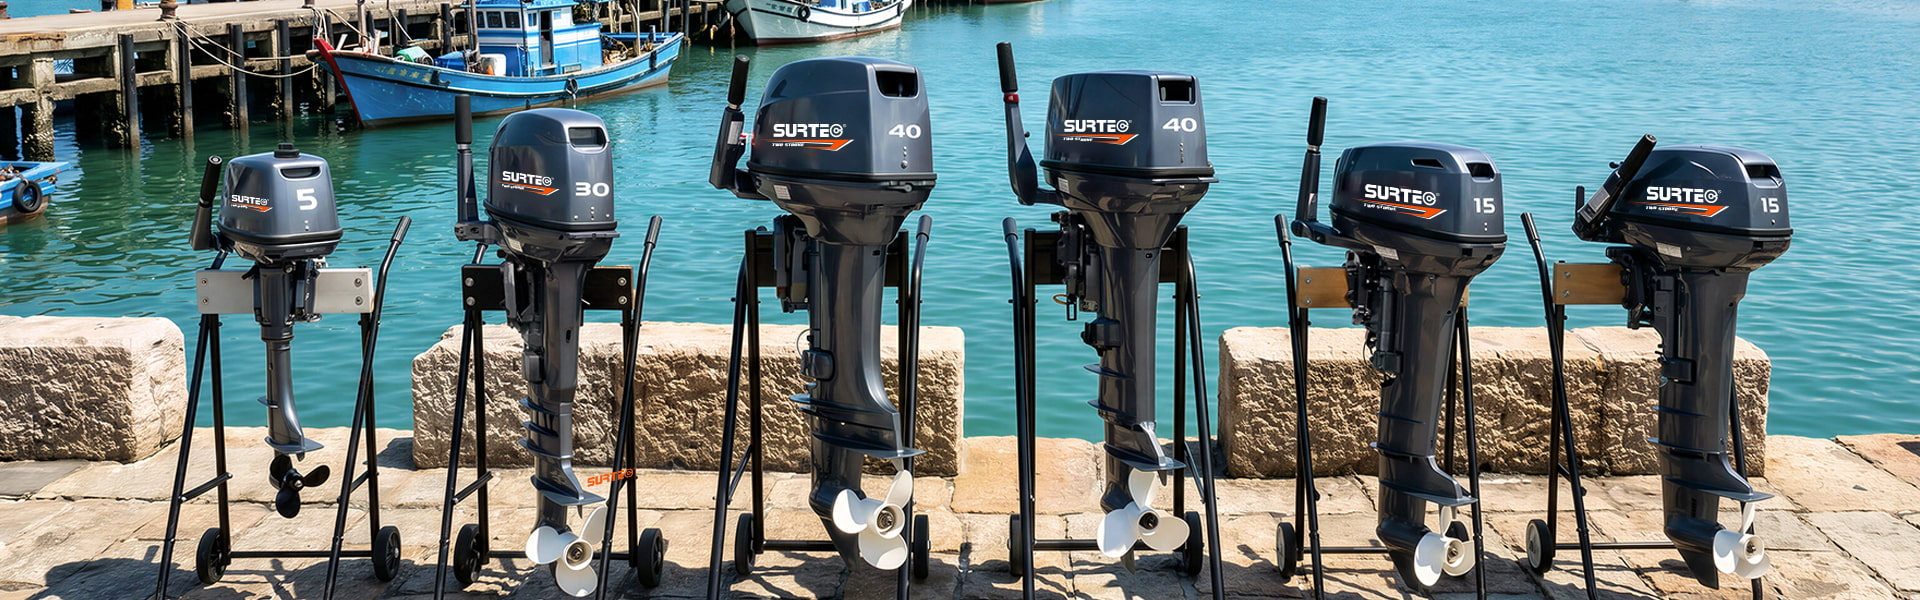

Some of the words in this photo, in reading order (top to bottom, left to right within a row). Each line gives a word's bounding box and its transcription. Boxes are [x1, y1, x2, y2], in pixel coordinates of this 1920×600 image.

[888, 124, 922, 139] 40
[1162, 117, 1198, 133] 40
[575, 181, 610, 197] 30
[296, 188, 318, 211] 5
[1473, 197, 1496, 214] 15
[1760, 197, 1780, 213] 15
